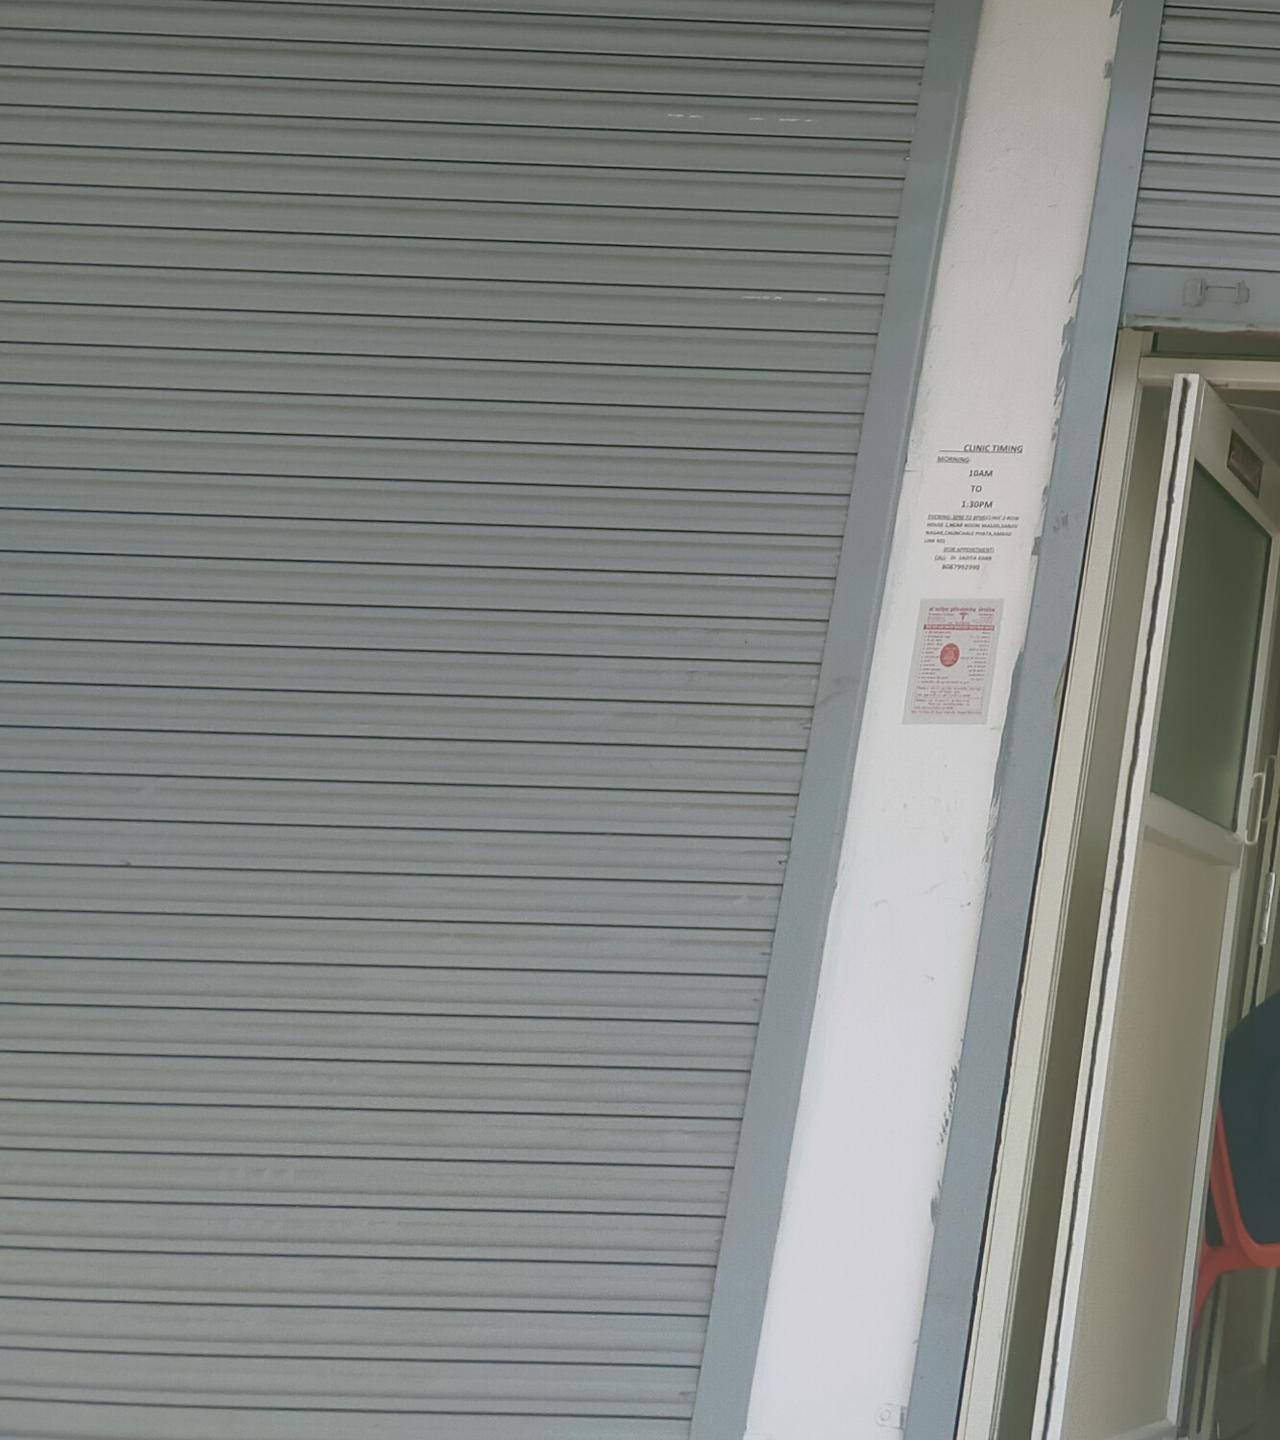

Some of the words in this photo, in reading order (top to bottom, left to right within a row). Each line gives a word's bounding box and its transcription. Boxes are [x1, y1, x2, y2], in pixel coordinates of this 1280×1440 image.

[963, 443, 991, 453] CLINIC
[992, 444, 1024, 454] TIMING
[968, 469, 993, 478] 10AM
[970, 485, 982, 493] TO
[961, 500, 993, 509] 1:30PM
